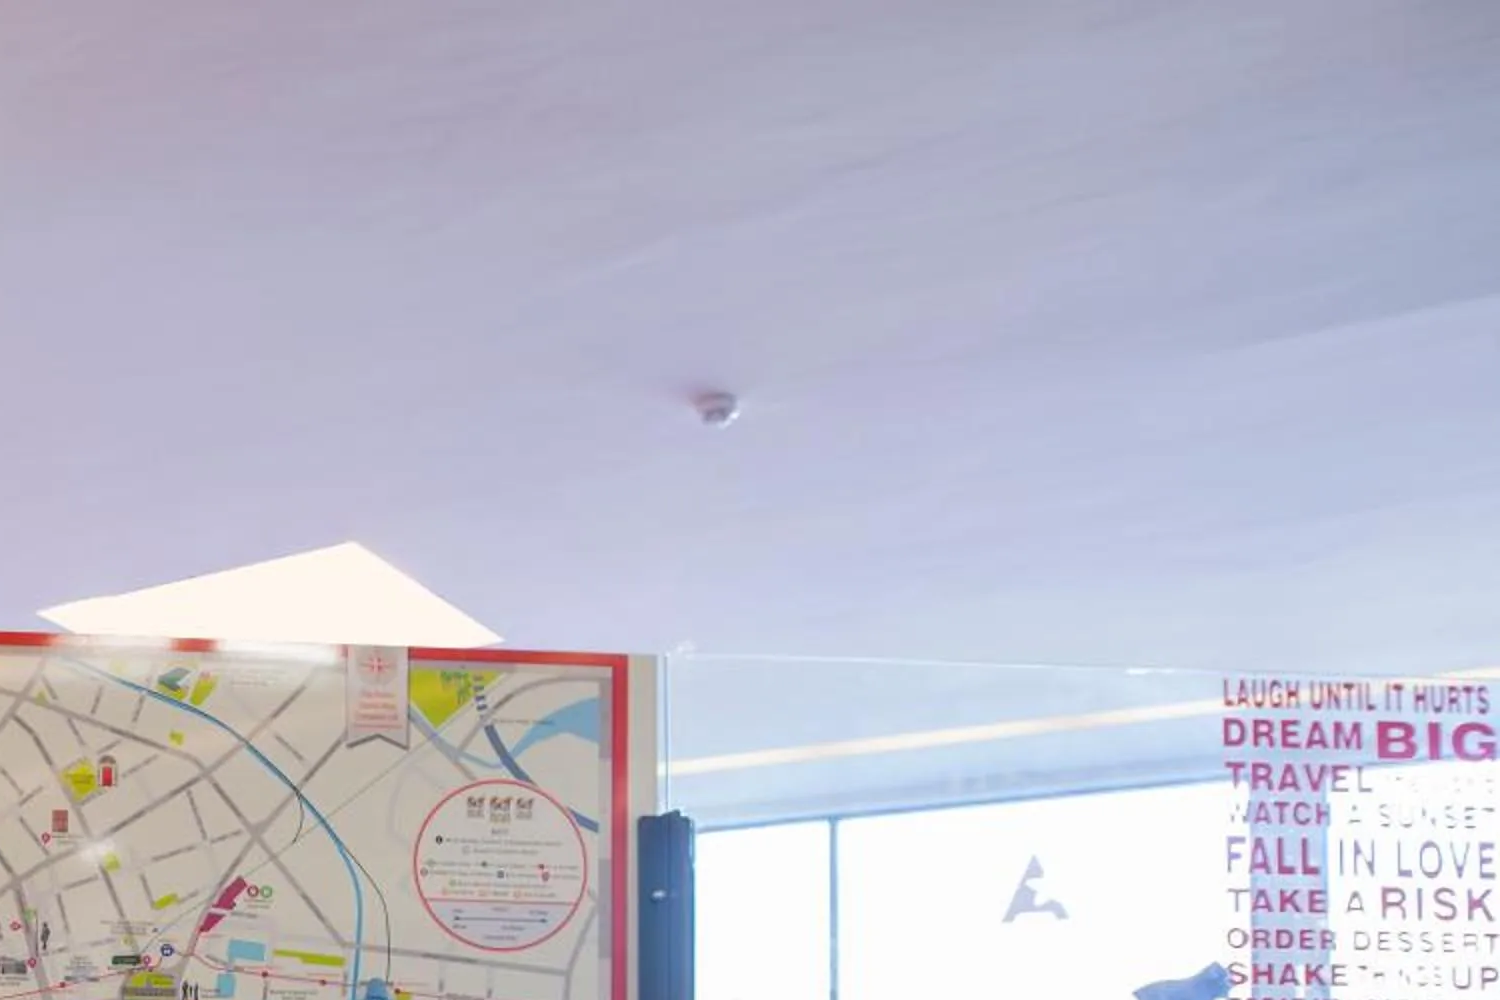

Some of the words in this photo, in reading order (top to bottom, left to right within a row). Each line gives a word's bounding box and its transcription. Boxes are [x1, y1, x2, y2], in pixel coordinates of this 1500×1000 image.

[1223, 678, 1301, 708] LAUGH
[1310, 680, 1376, 711] UNTIL
[1385, 683, 1404, 711] IT
[1413, 685, 1491, 715] HURTS
[1223, 717, 1363, 750] DREAM
[1376, 720, 1497, 761] BIG
[1224, 762, 1373, 793] TRAVEL
[1226, 836, 1320, 875] FALL
[1339, 839, 1375, 877] IN
[1397, 840, 1496, 879] LOVE
[1227, 888, 1327, 913] TAKE
[1347, 890, 1365, 913] A
[1381, 887, 1495, 921] RISK
[1227, 928, 1336, 950] ORDER
[1353, 930, 1500, 953] DESSERT
[1227, 962, 1348, 986] SHAKE
[1452, 966, 1499, 990] UP
